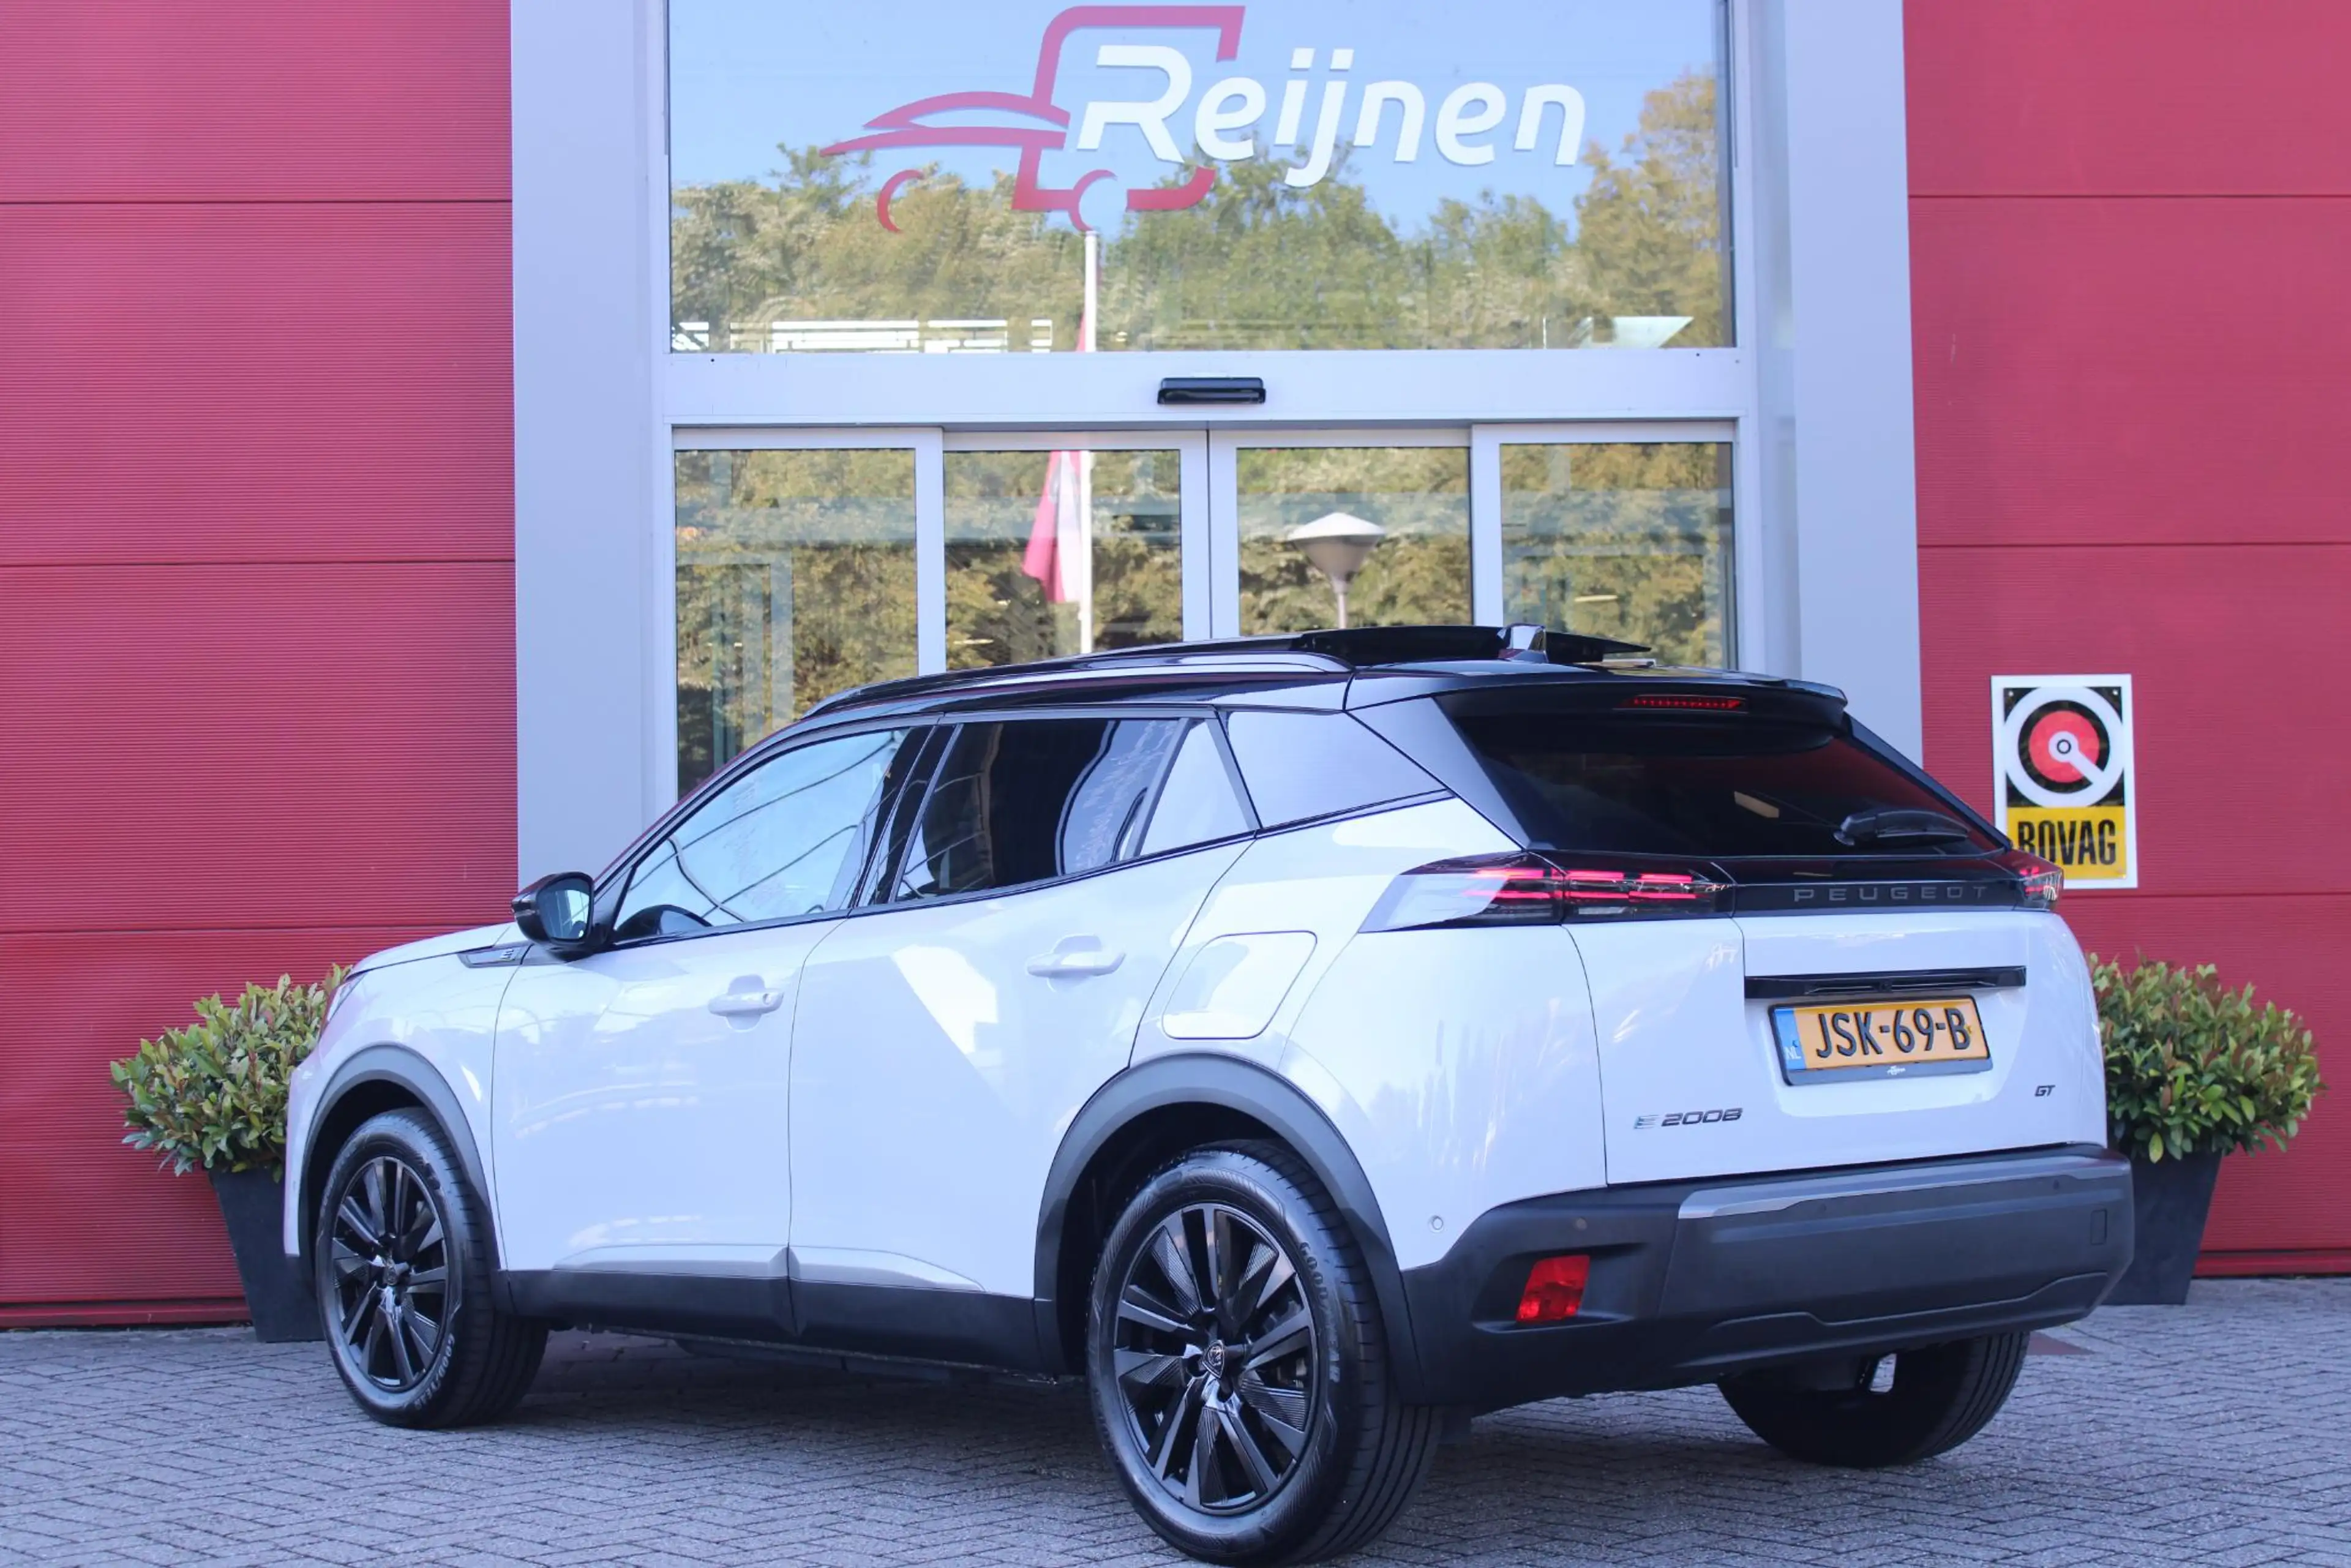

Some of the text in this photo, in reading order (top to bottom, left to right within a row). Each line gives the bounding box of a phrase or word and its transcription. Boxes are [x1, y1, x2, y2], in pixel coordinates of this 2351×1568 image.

[1076, 44, 1587, 188] Reijnen
[2017, 819, 2117, 866] BOVAG
[1793, 886, 1987, 902] PEUGEOT
[1816, 1007, 1971, 1059] JSK-69-B
[1784, 1046, 1802, 1060] NL
[2034, 1084, 2056, 1097] GT
[1661, 1108, 1744, 1127] 2008
